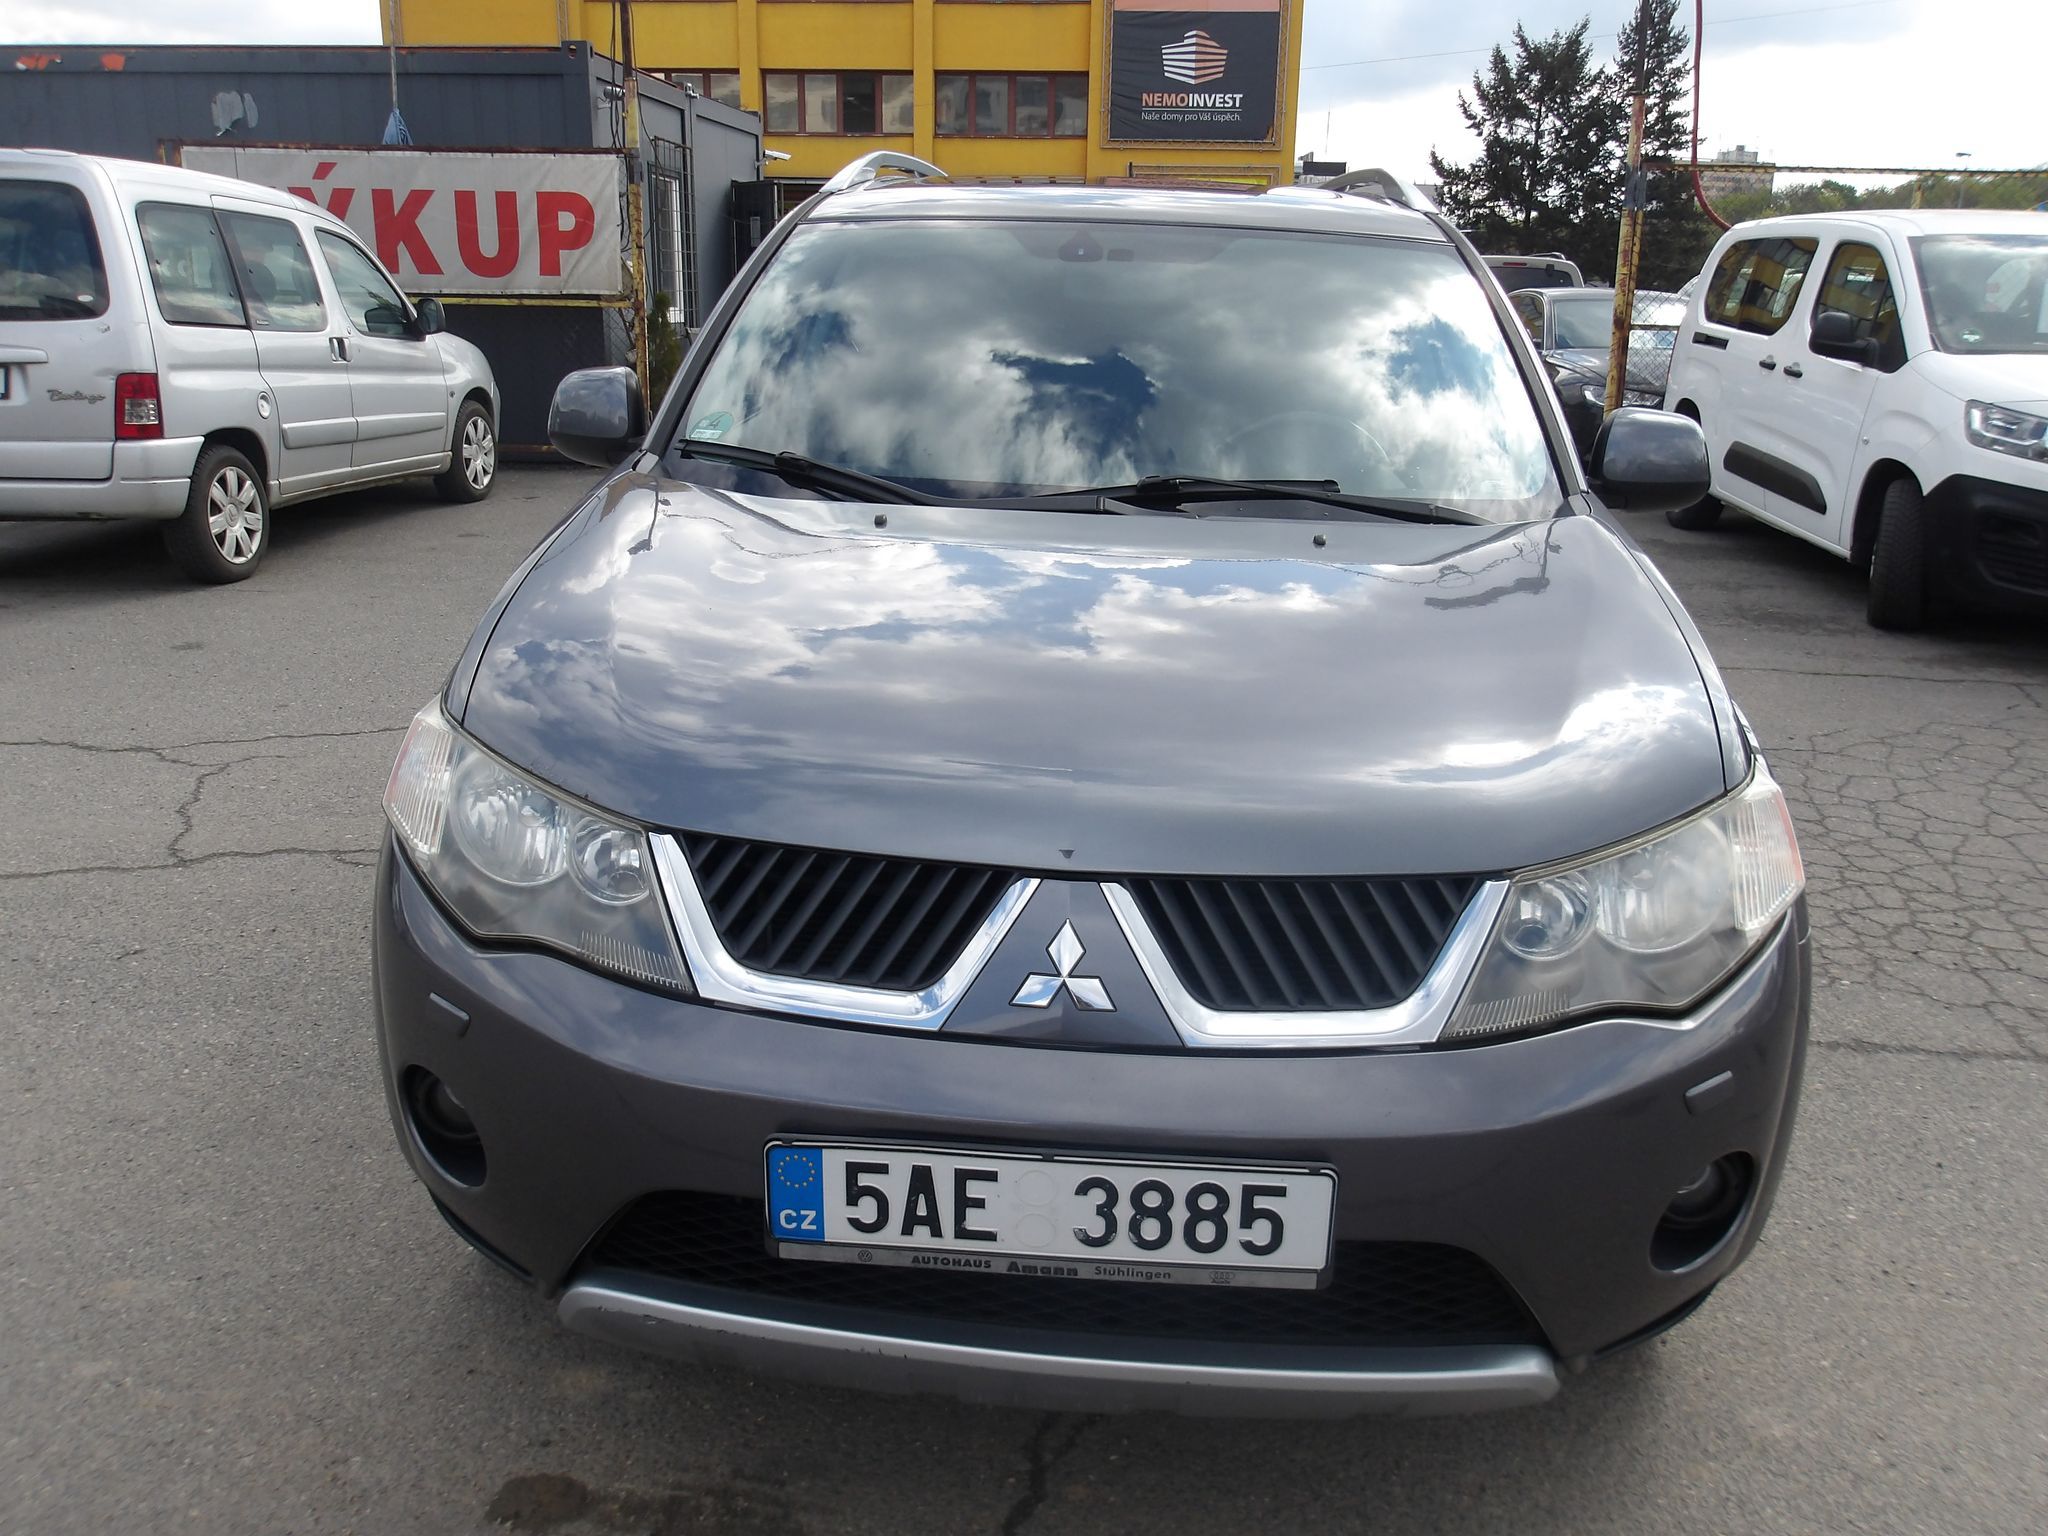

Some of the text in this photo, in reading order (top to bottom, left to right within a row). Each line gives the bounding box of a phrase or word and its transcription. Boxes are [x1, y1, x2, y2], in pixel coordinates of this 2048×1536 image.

[1142, 93, 1243, 108] NEMOINVEST
[1141, 112, 1160, 121] Naše
[1161, 112, 1183, 122] domy
[1184, 113, 1198, 122] pro
[1199, 112, 1211, 121] Váš
[270, 162, 596, 278] ÝKUP
[779, 1209, 817, 1230] CZ
[845, 1161, 1287, 1255] 5AE 3885
[911, 1255, 993, 1269] AUTOHAUS
[1095, 1265, 1172, 1280] Stühlingen
